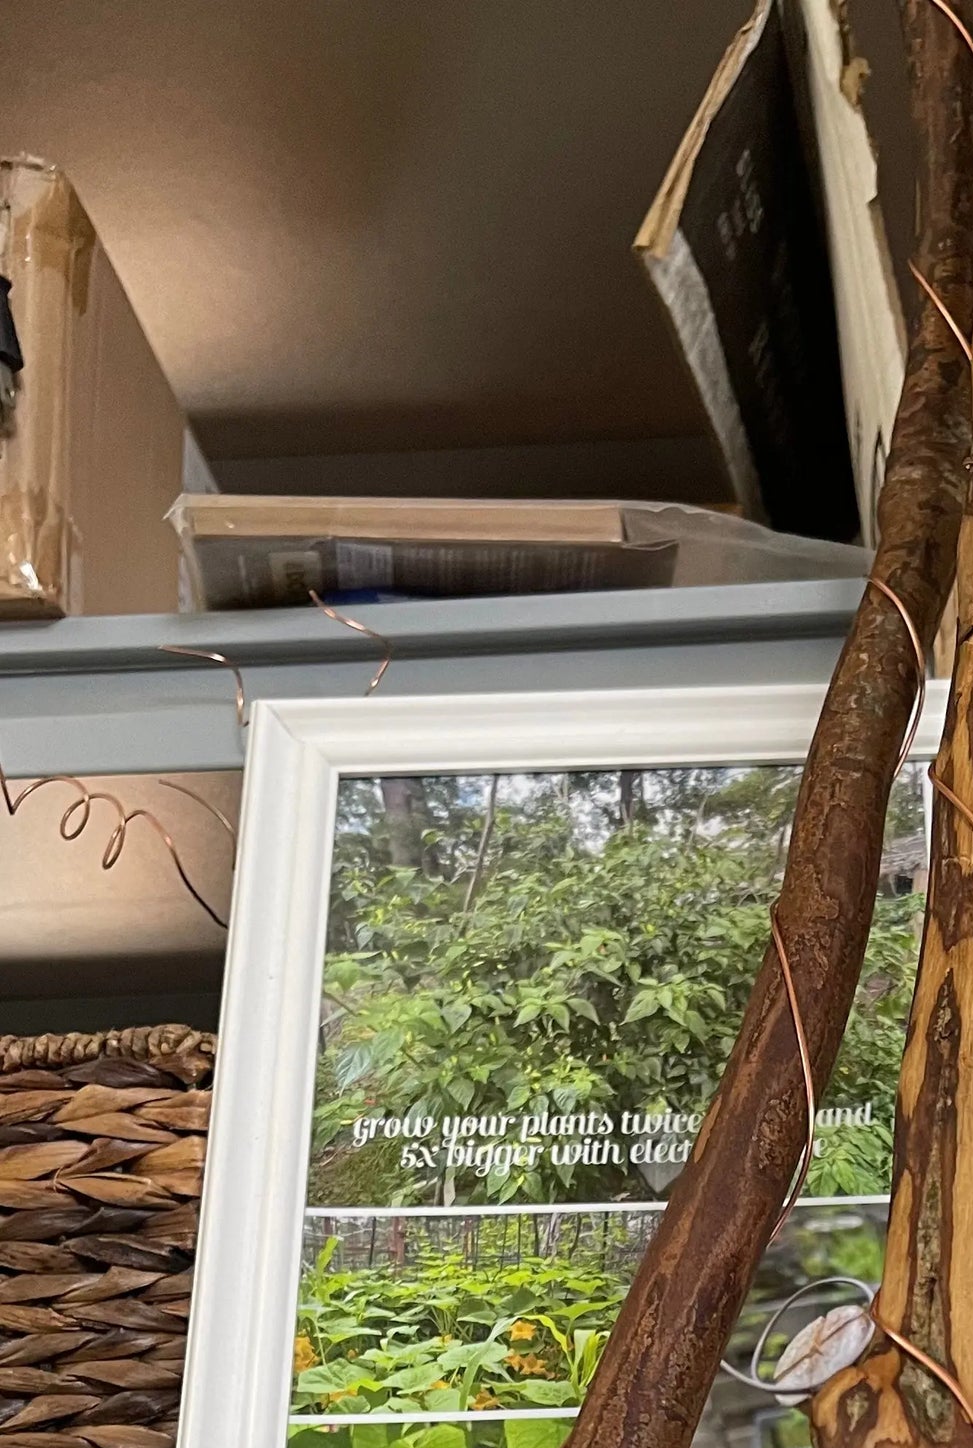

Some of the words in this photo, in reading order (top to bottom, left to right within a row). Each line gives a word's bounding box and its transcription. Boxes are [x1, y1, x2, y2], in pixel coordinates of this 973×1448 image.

[352, 1114, 437, 1147] grow
[441, 1112, 516, 1147] your
[520, 1110, 614, 1143] plants
[621, 1108, 706, 1135] twice
[815, 1102, 873, 1127] and
[446, 1139, 542, 1177] bigger
[549, 1139, 624, 1166] with
